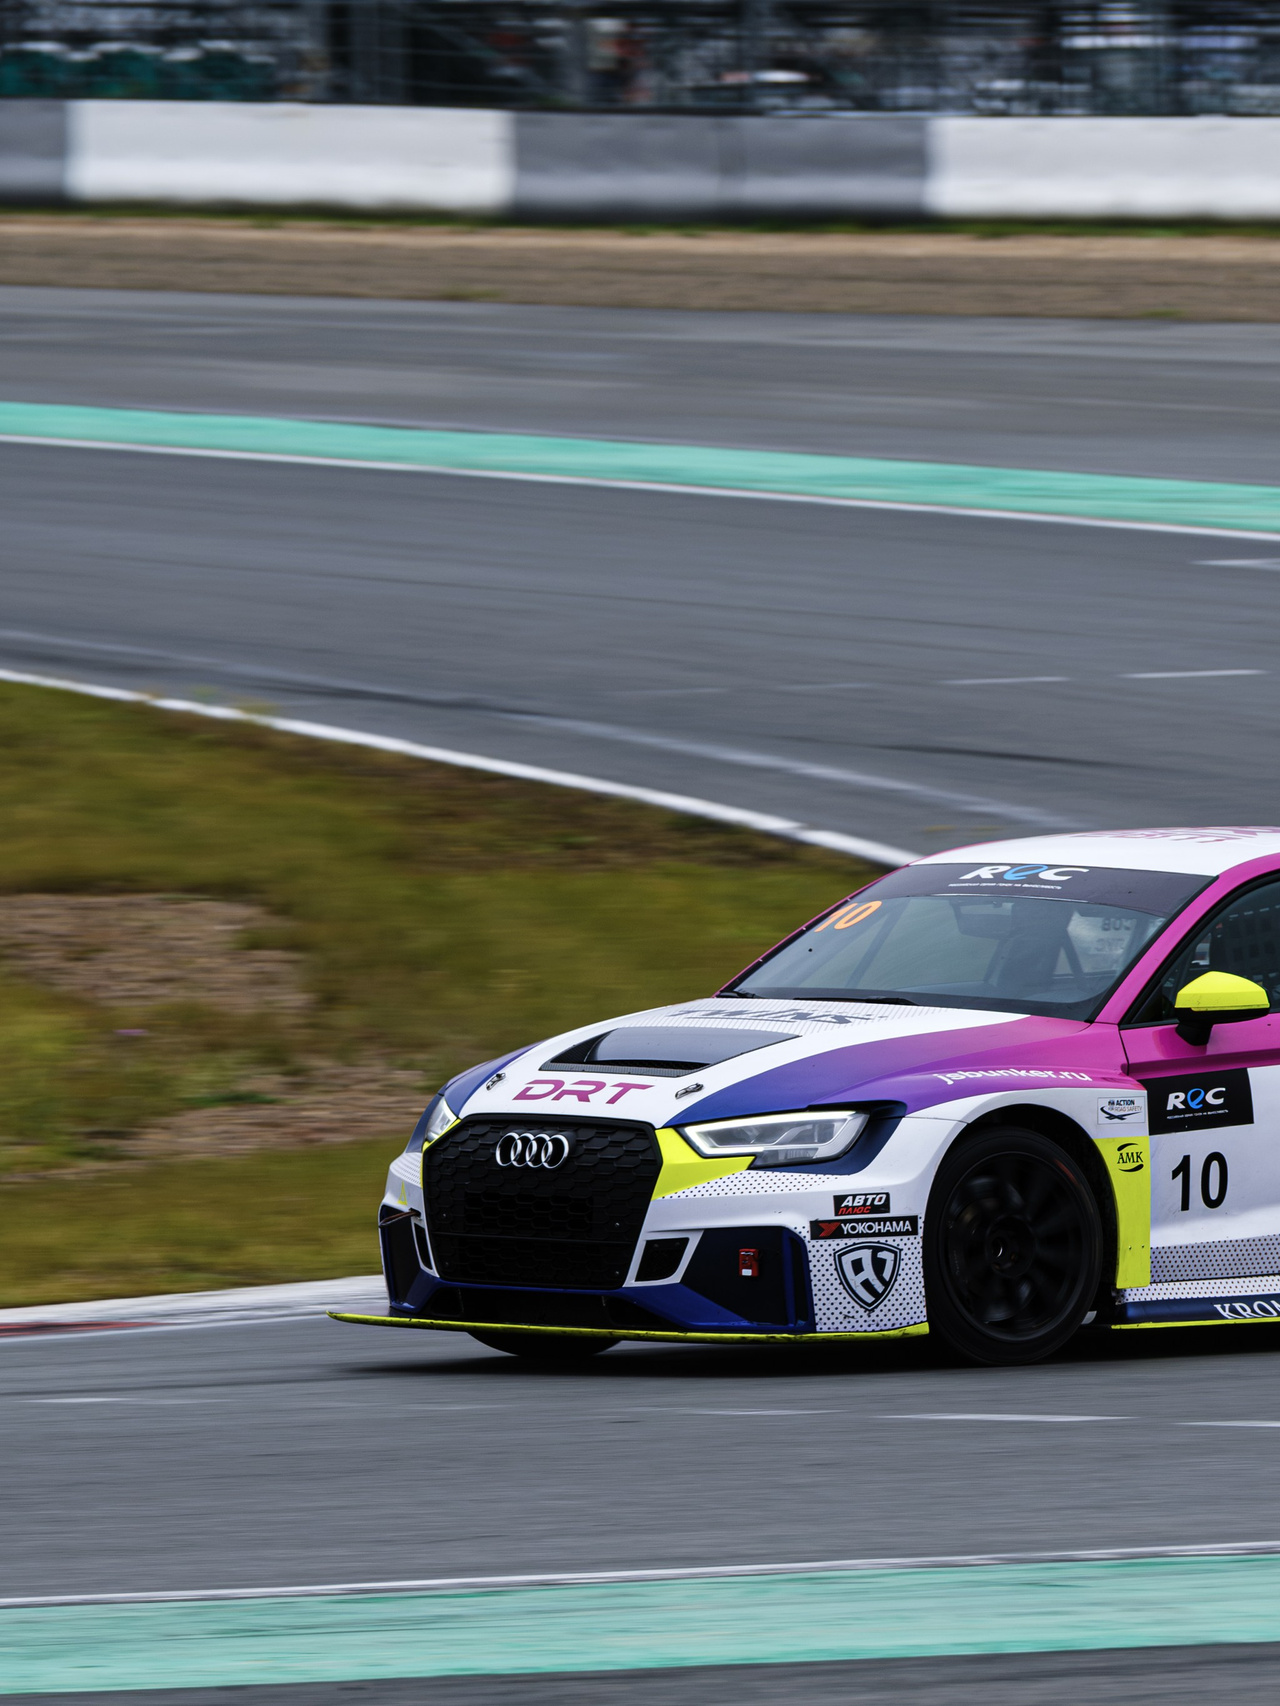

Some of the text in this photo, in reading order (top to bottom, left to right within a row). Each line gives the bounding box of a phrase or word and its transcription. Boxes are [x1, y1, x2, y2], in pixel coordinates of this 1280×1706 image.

[814, 901, 883, 933] 10
[933, 1069, 1093, 1085] jsbunker.ru
[512, 1079, 655, 1105] DRT
[1172, 1151, 1229, 1212] 10
[841, 1194, 887, 1207] АВТО
[838, 1206, 872, 1215] ПЛЮС
[841, 1220, 912, 1235] YOKOHAMA
